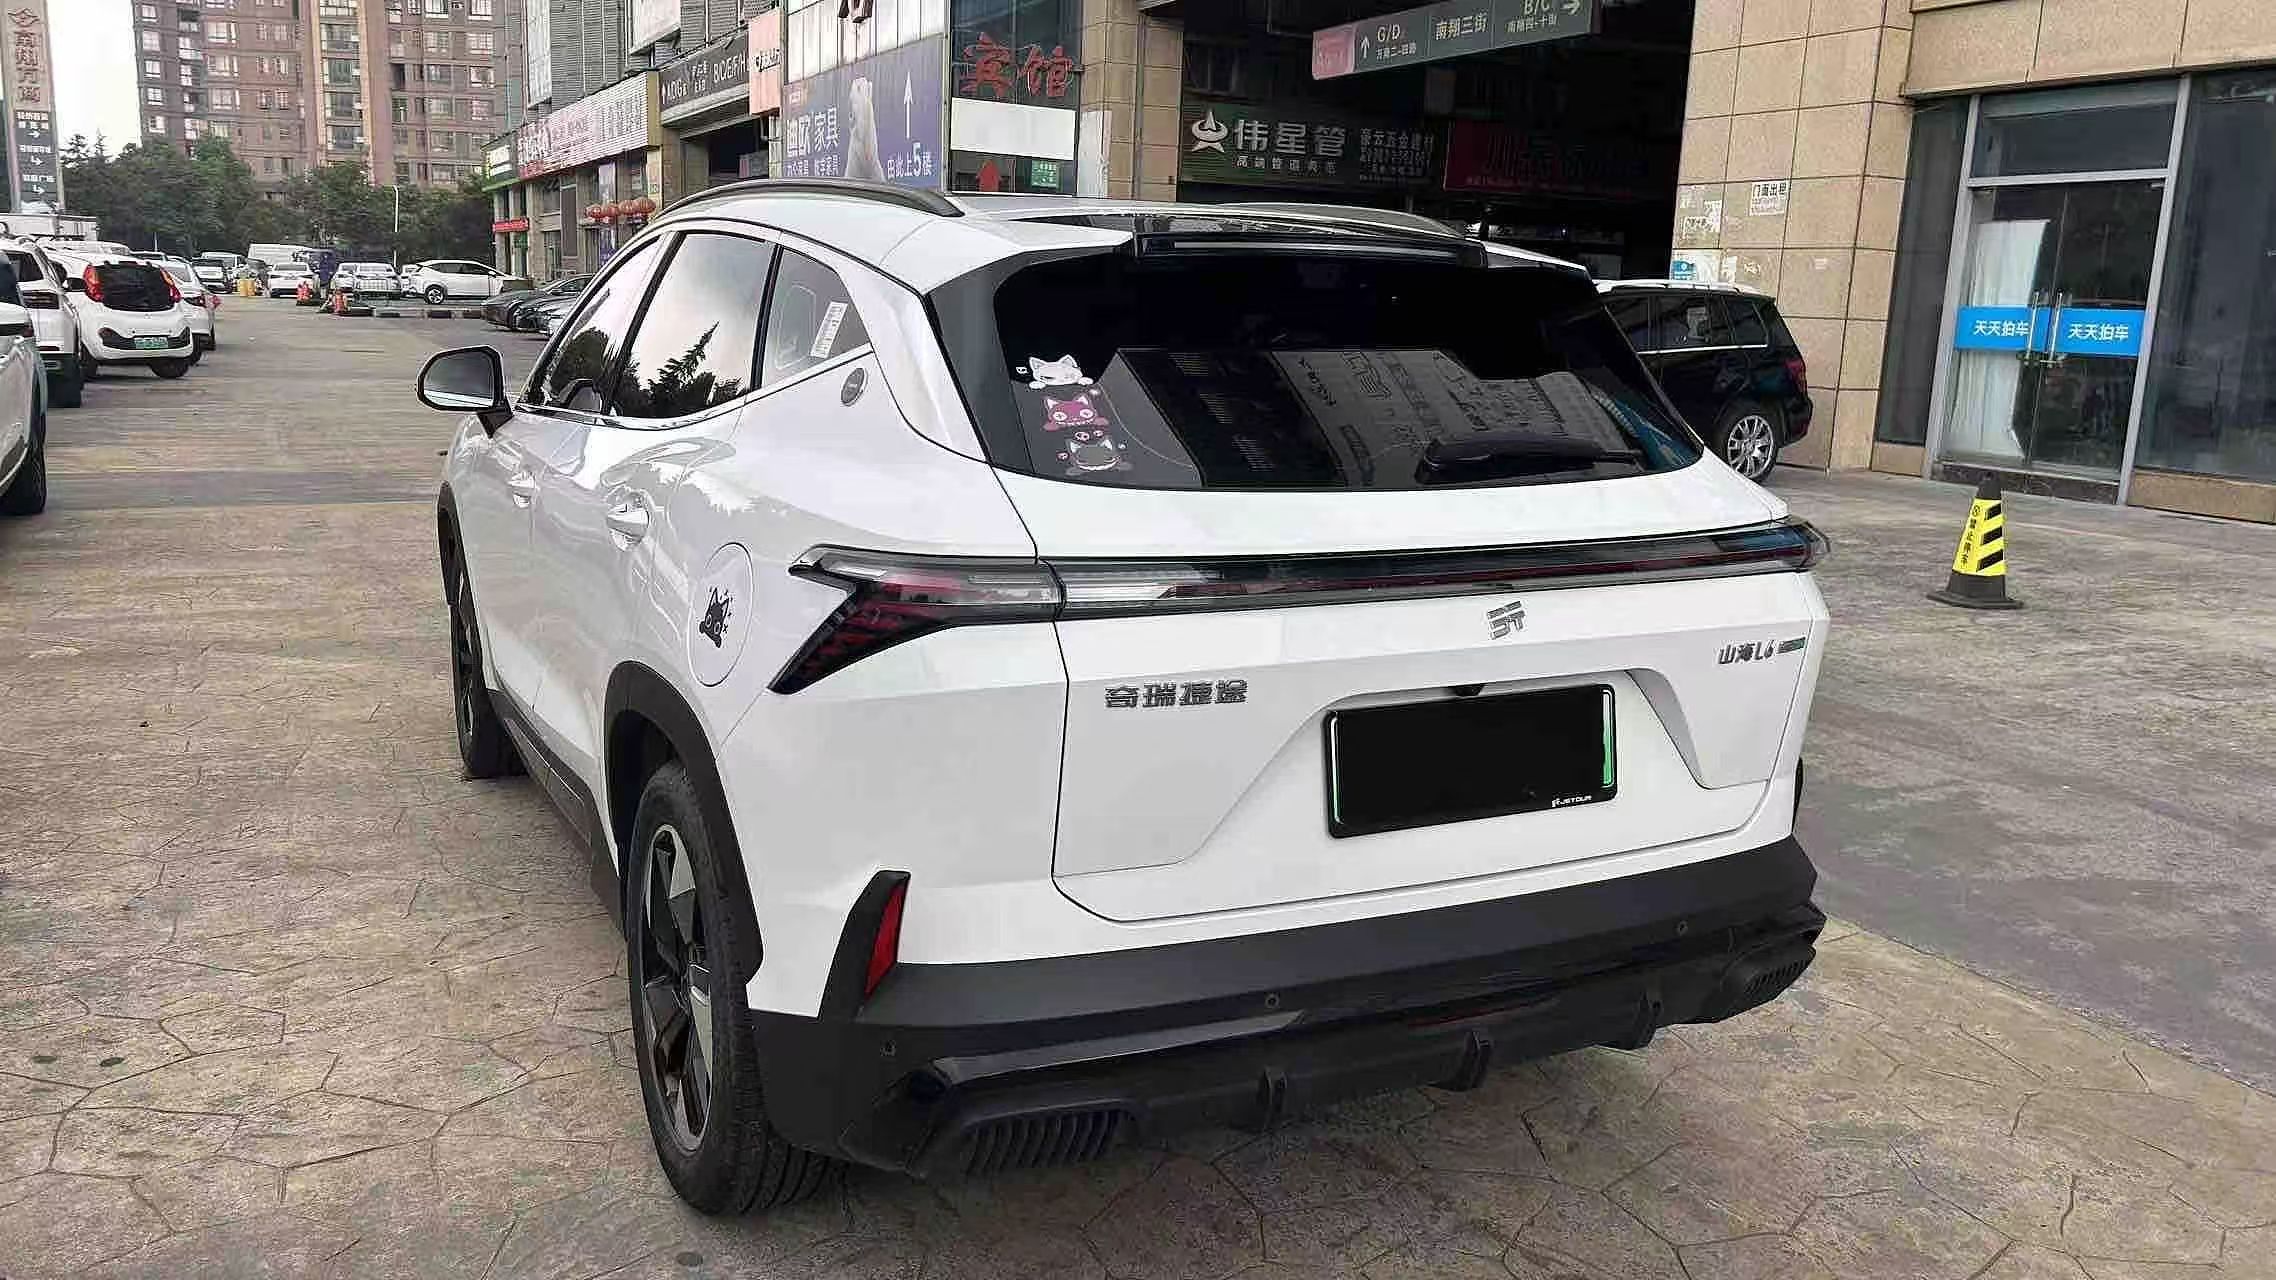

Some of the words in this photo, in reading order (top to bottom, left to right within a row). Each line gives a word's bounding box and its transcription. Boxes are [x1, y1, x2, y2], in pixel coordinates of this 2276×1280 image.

[1435, 13, 1488, 40] 南翔三街
[960, 32, 1073, 97] 宾馆
[1233, 119, 1347, 158] 伟星管
[1973, 319, 2030, 336] 天天拍车
[2067, 323, 2129, 341] 天天拍车
[1105, 679, 1248, 708] 奇瑞捷途
